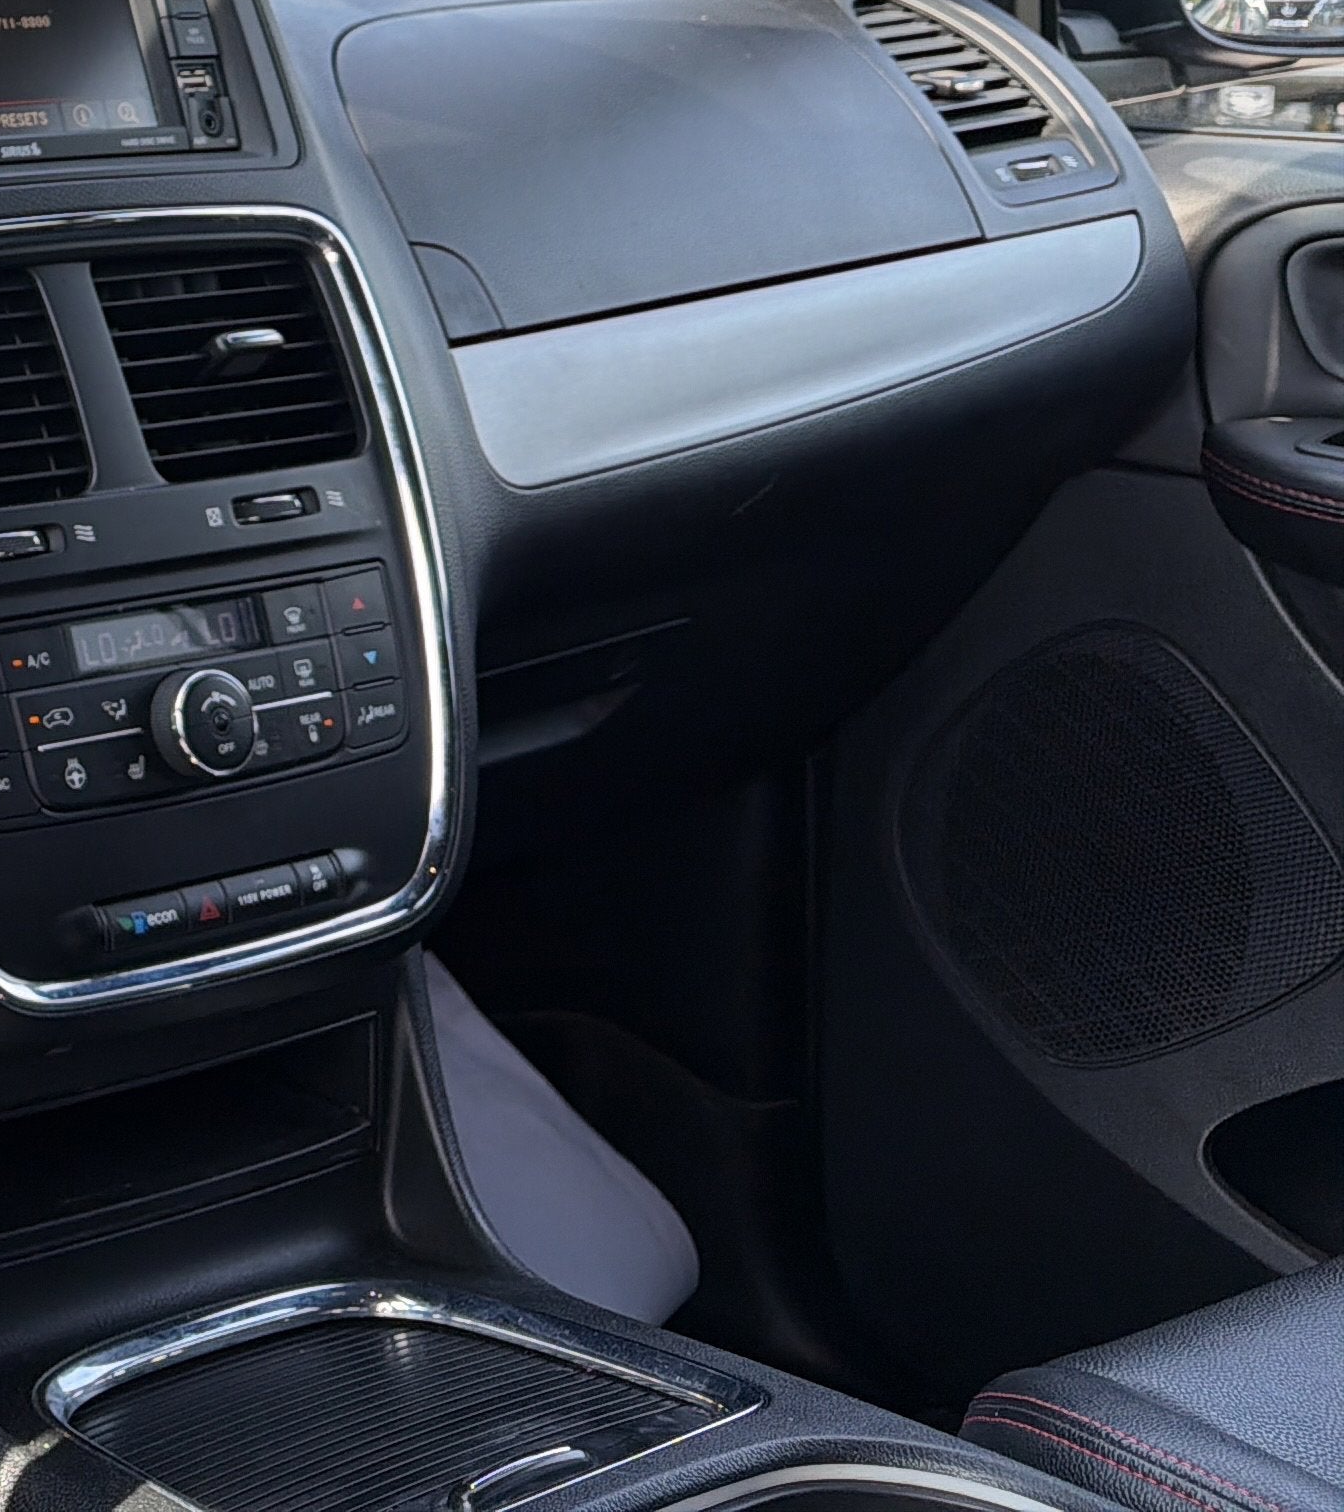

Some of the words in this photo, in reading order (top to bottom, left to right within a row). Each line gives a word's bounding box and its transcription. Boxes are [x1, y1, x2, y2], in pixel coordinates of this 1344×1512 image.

[27, 651, 50, 669] A/C
[248, 674, 275, 690] AUTO
[218, 741, 236, 755] OFF
[259, 884, 292, 900] POWER
[147, 908, 178, 927] econ
